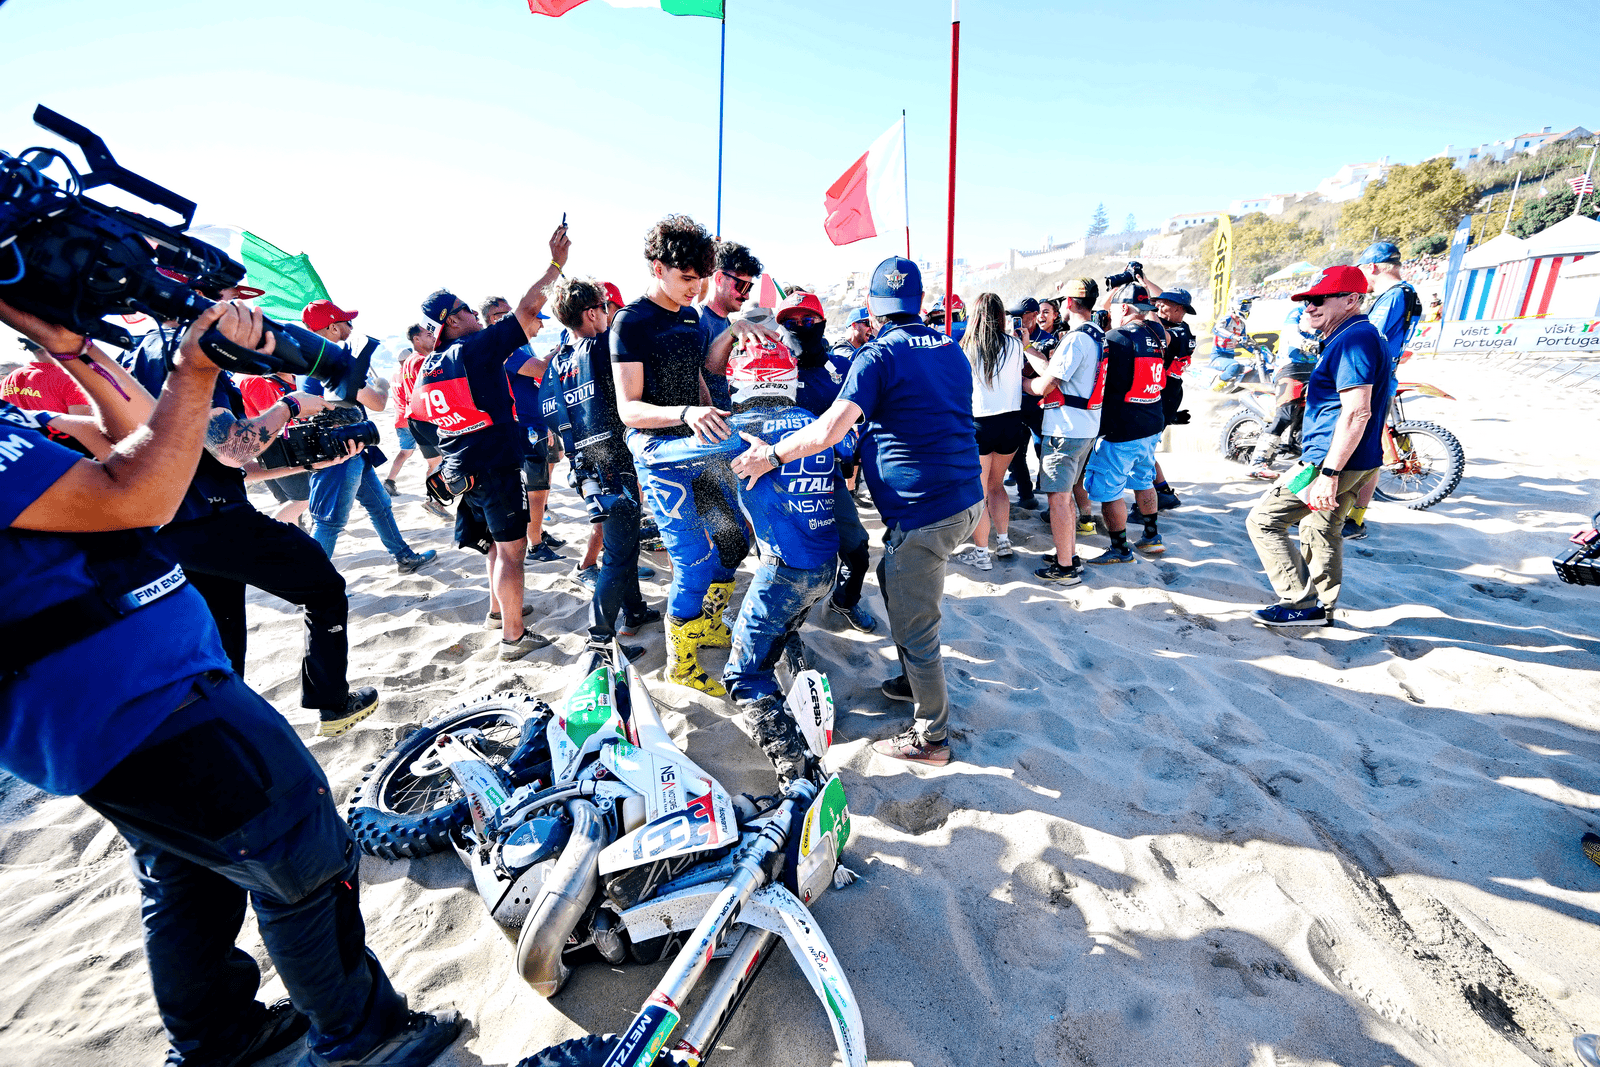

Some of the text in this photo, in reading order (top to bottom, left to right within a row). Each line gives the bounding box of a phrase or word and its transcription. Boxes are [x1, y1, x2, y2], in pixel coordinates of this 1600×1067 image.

[1461, 326, 1490, 336] visit
[1545, 324, 1575, 334] visit
[1406, 339, 1436, 350] ugal
[1453, 337, 1518, 349] Portugal
[1536, 336, 1600, 348] Portuga
[211, 343, 238, 361] Canon
[4, 384, 42, 398] ESPAÑA
[763, 417, 815, 434] CRIST
[135, 584, 161, 602] FIM
[571, 691, 596, 712] 16
[806, 677, 822, 727] ACERBIS
[720, 893, 737, 916] XPLOR
